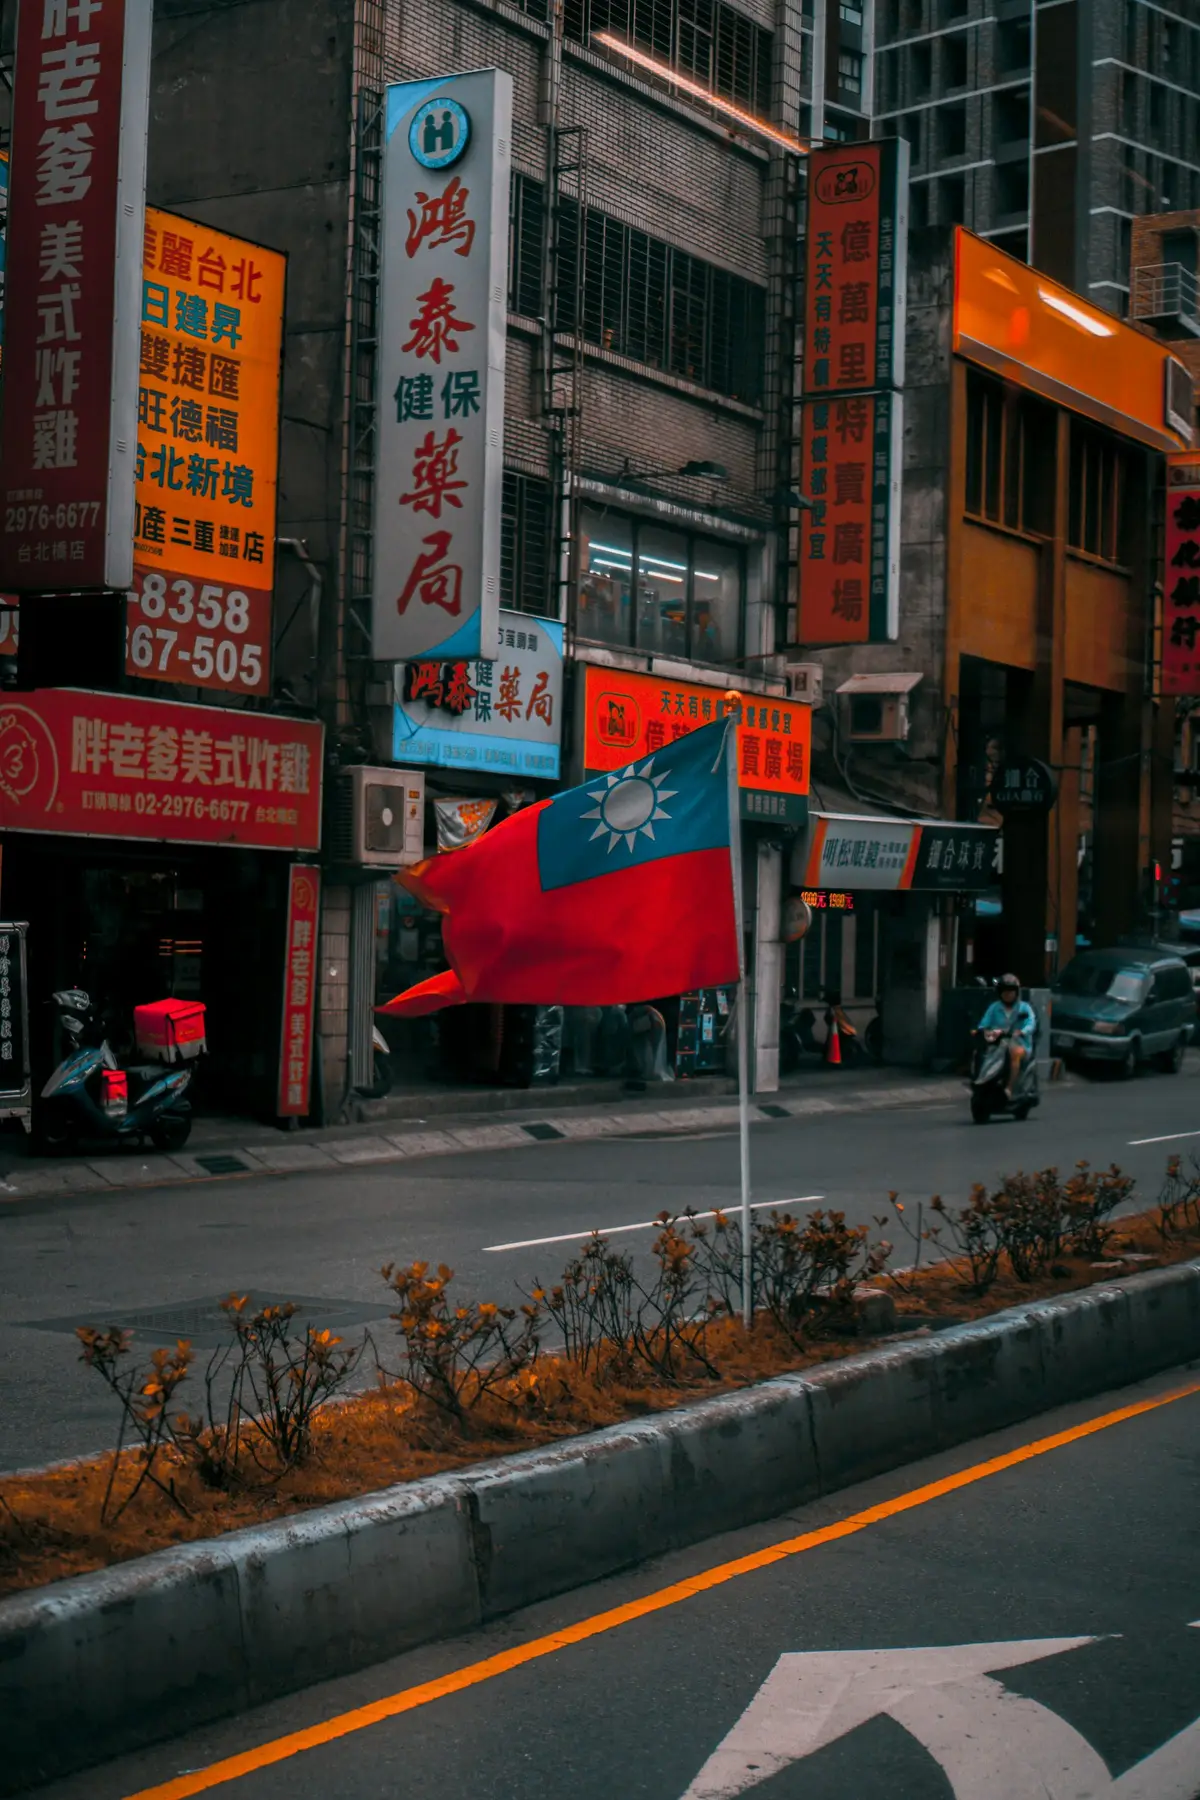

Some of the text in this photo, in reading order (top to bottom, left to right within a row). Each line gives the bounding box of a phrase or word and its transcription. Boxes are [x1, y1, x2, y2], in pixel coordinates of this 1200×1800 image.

[401, 176, 476, 366] 鴻泰
[32, 219, 84, 470] 美式炸雞
[142, 279, 242, 350] 日建昇
[137, 387, 239, 454] 旺德福
[393, 369, 481, 424] 健保
[4, 501, 102, 533] 2976-6677
[243, 530, 265, 564] 店
[396, 427, 470, 617] 藥局
[18, 540, 85, 563] 台北橋店
[125, 624, 263, 687] 67-505
[475, 661, 494, 723] 健保
[494, 665, 554, 727] 藥局
[71, 715, 310, 795] 胖老爹美式炸雞
[134, 792, 250, 823] 02-2976-6677
